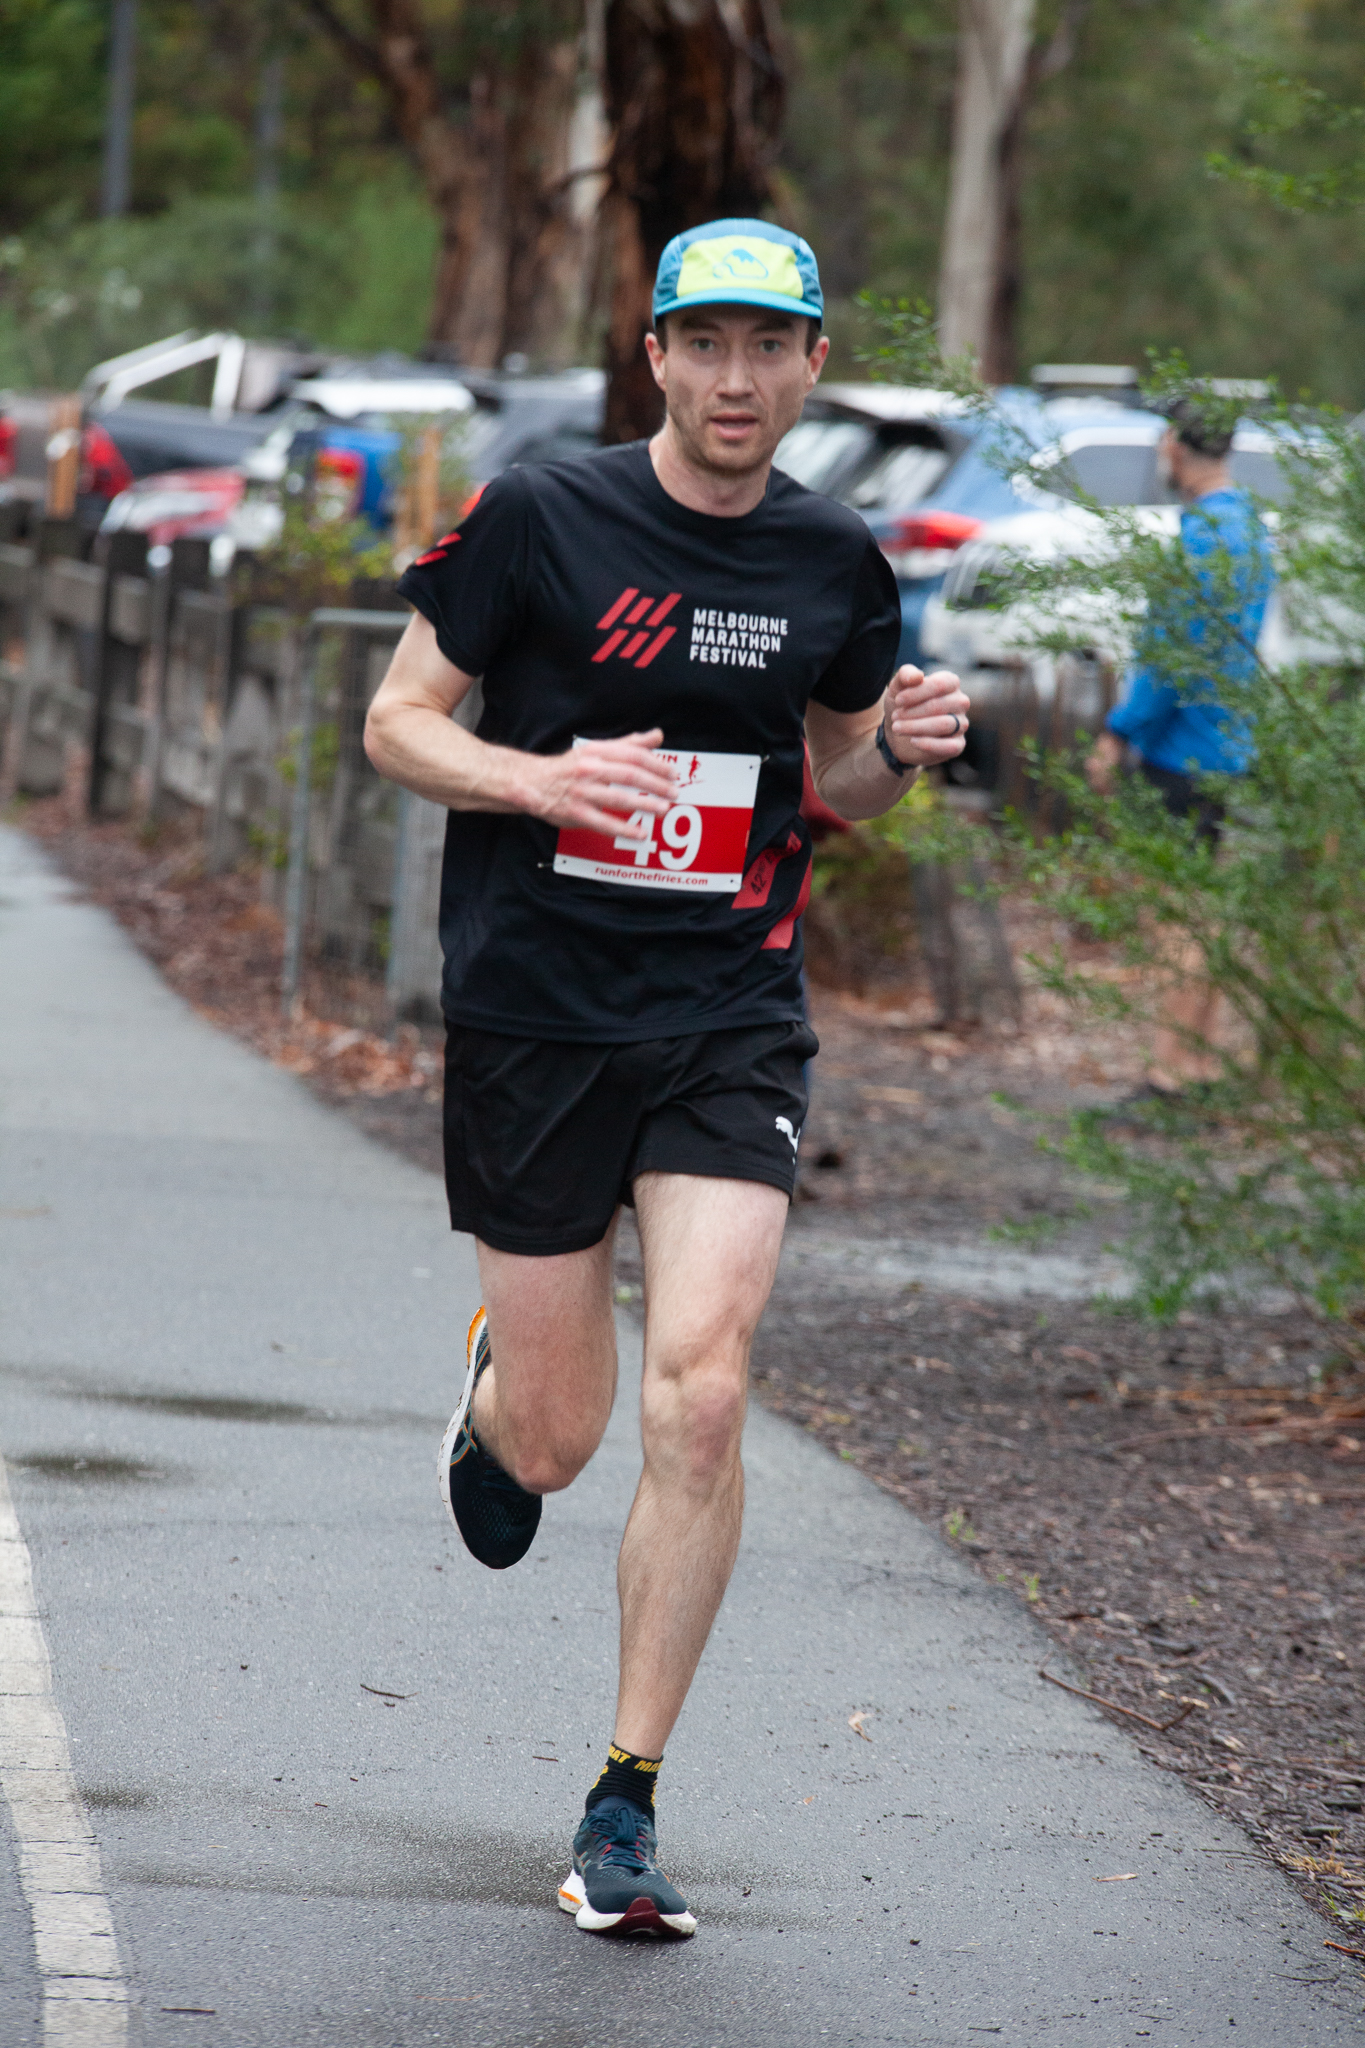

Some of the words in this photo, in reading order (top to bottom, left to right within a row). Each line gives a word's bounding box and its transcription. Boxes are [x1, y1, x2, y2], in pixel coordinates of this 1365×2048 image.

[693, 608, 788, 635] MELBOURNE
[691, 626, 781, 652] MARATHON
[689, 644, 767, 669] FESTIVAL
[613, 804, 703, 871] 49
[595, 867, 709, 886] runforthefiries.com
